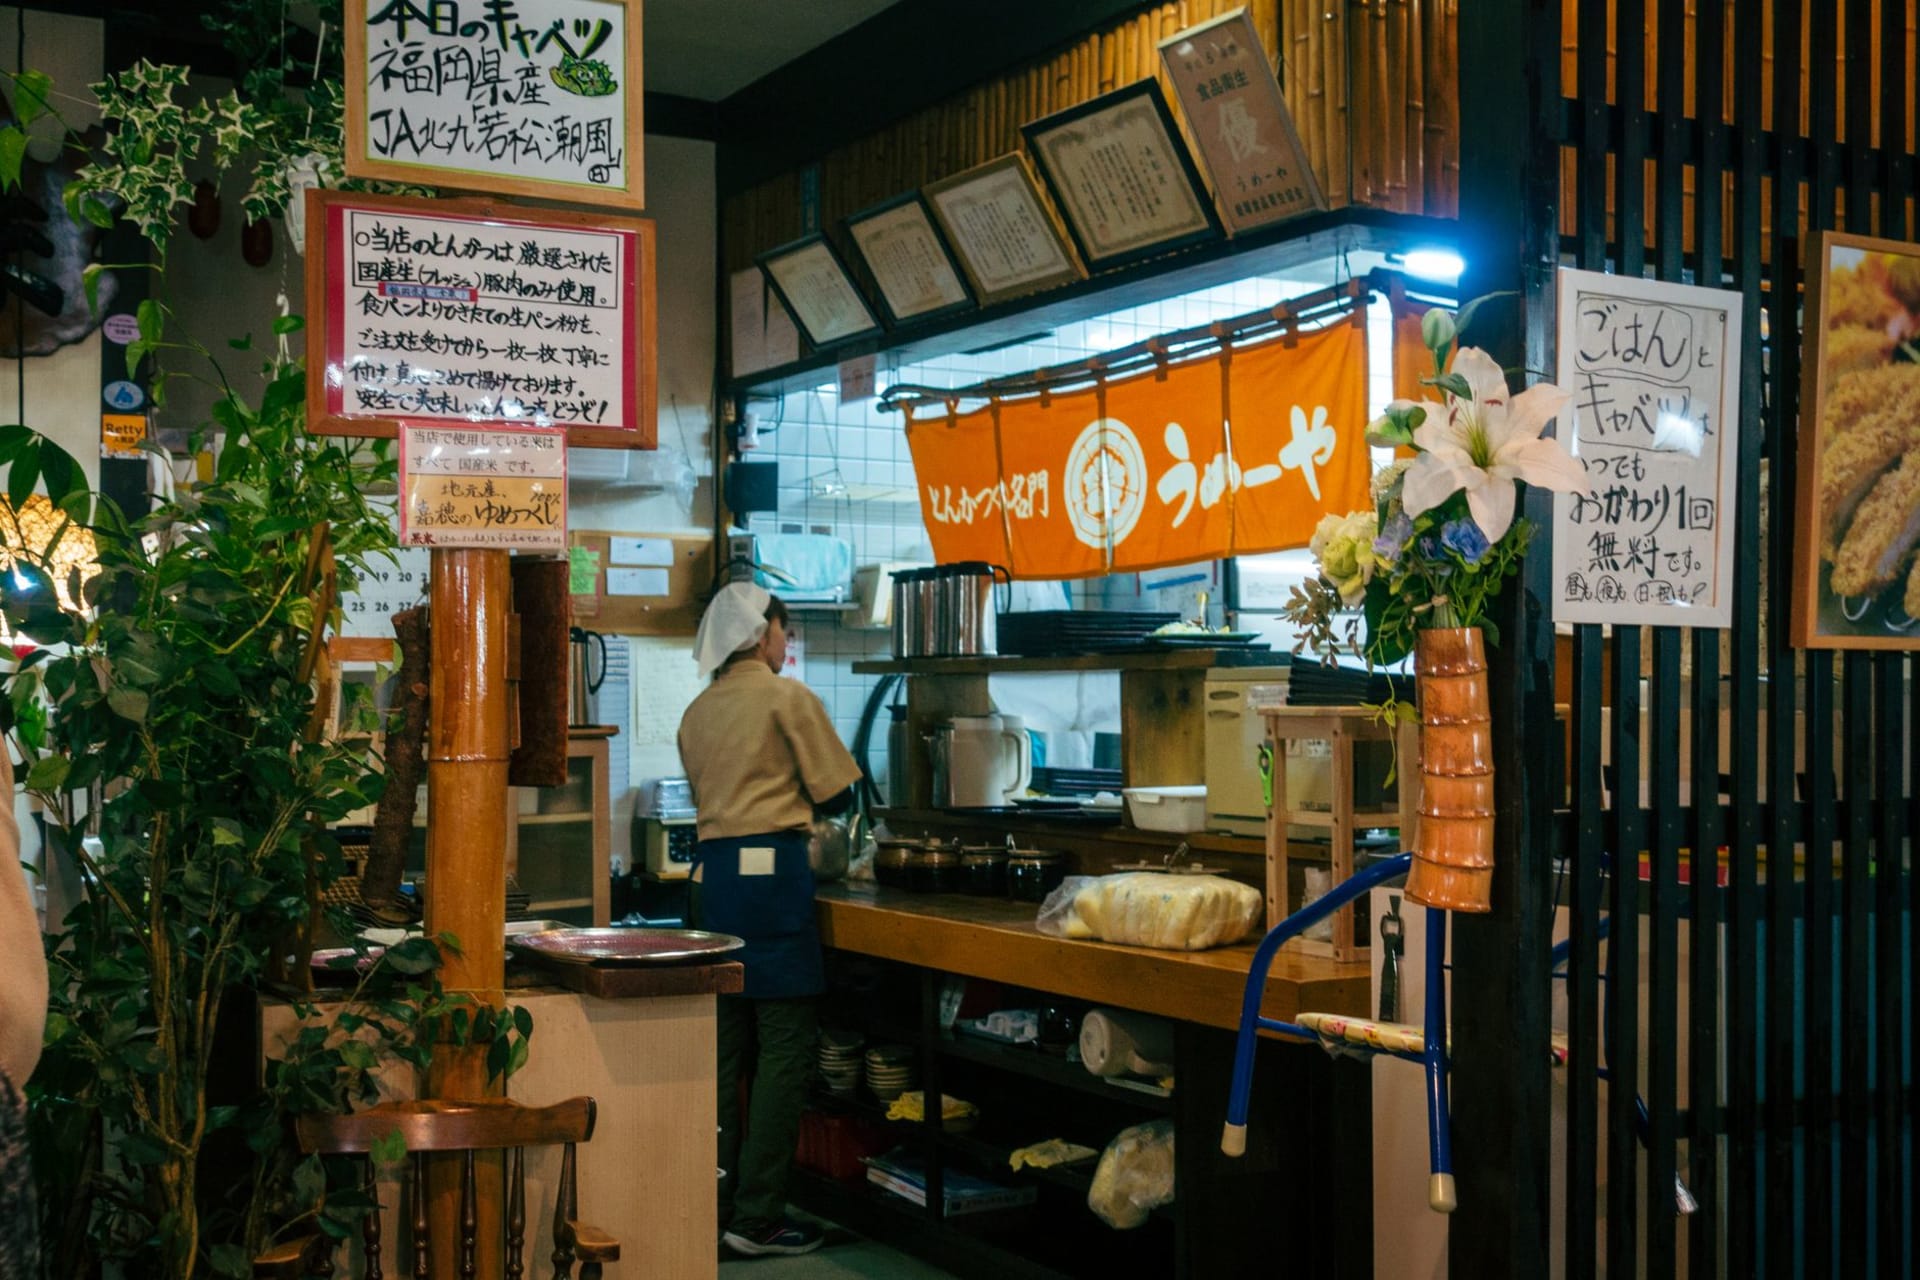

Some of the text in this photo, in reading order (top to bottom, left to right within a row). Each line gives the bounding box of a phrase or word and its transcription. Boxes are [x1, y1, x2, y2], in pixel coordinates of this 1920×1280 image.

[367, 0, 613, 58] 本日のキャベツ
[369, 39, 550, 106] 福岡県産
[105, 422, 143, 436] Retty
[413, 431, 554, 449] 当店で使用している米は
[1157, 404, 1336, 528] うめーや
[398, 572, 412, 582] 20
[351, 602, 412, 612] 25 26 27
